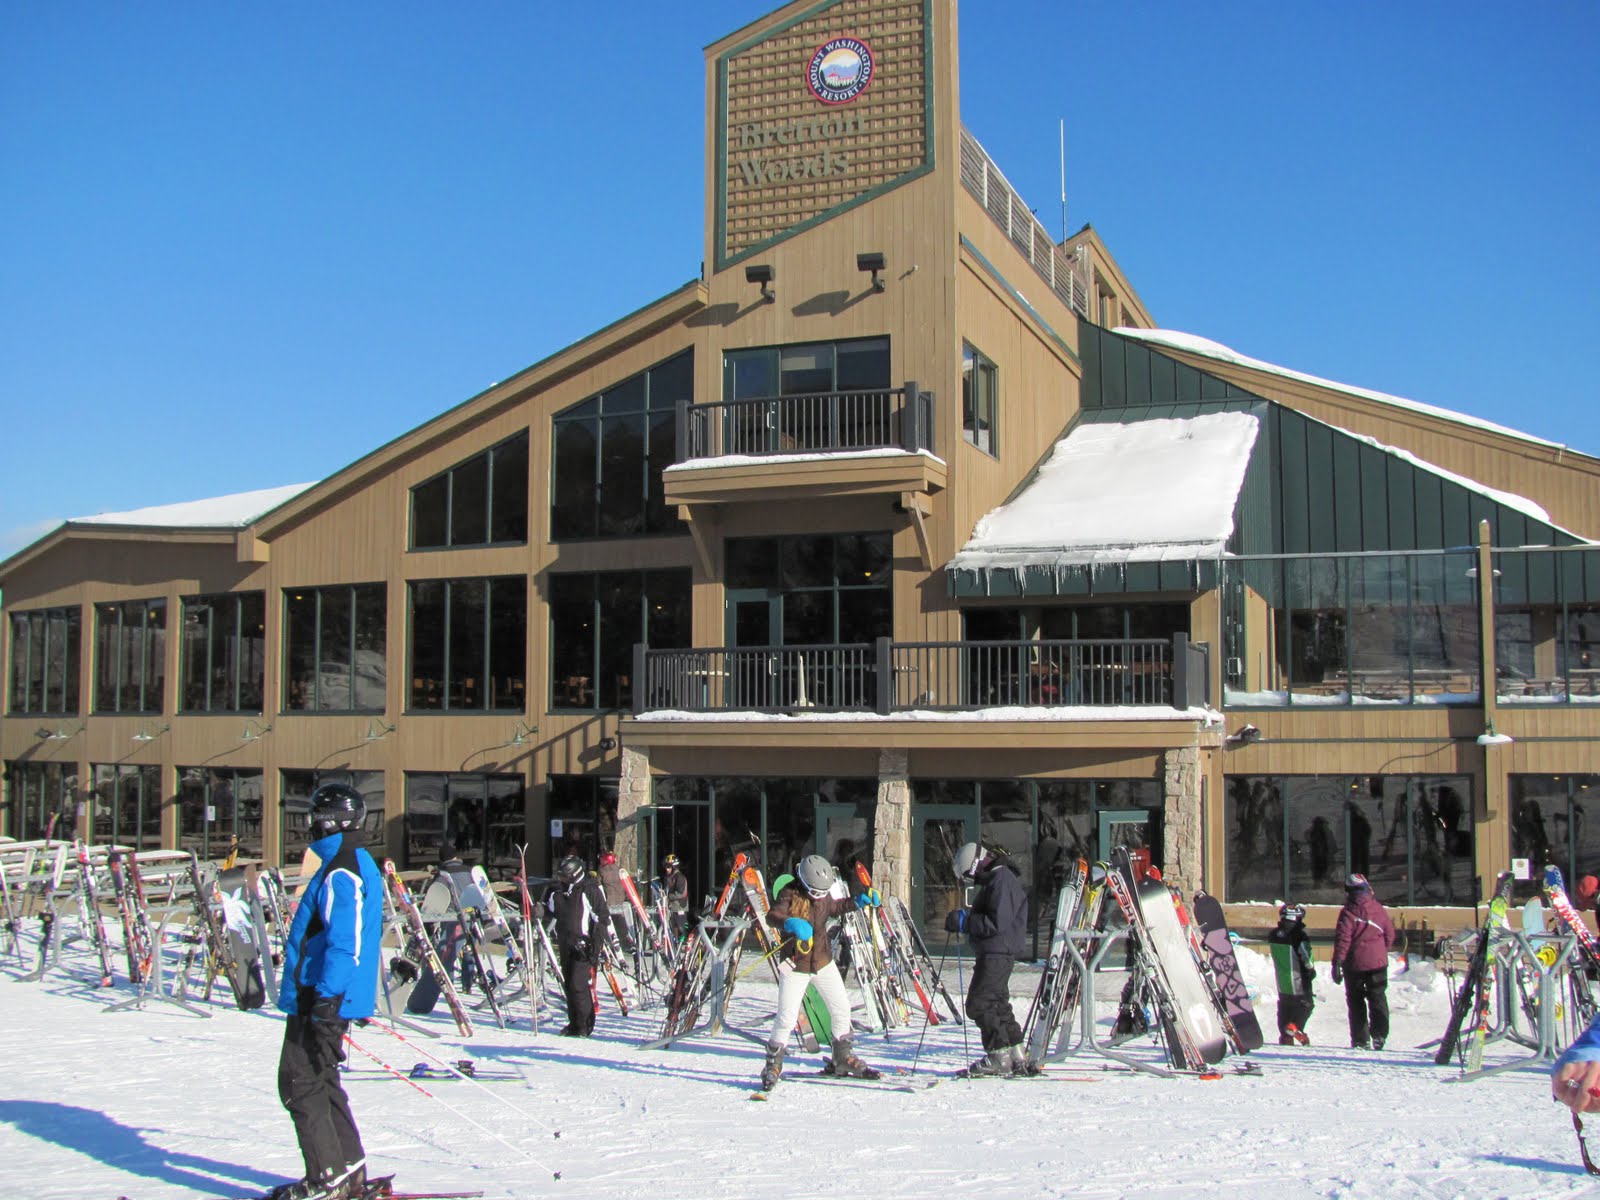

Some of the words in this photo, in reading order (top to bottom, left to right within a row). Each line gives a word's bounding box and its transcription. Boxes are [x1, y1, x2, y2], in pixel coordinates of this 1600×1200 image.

[810, 50, 825, 89] MOUNT
[825, 40, 871, 84] WASHINGTON
[821, 86, 860, 101] RESORT
[738, 116, 866, 149] Bretton
[739, 150, 849, 188] Woods
[1111, 874, 1134, 917] HEAD
